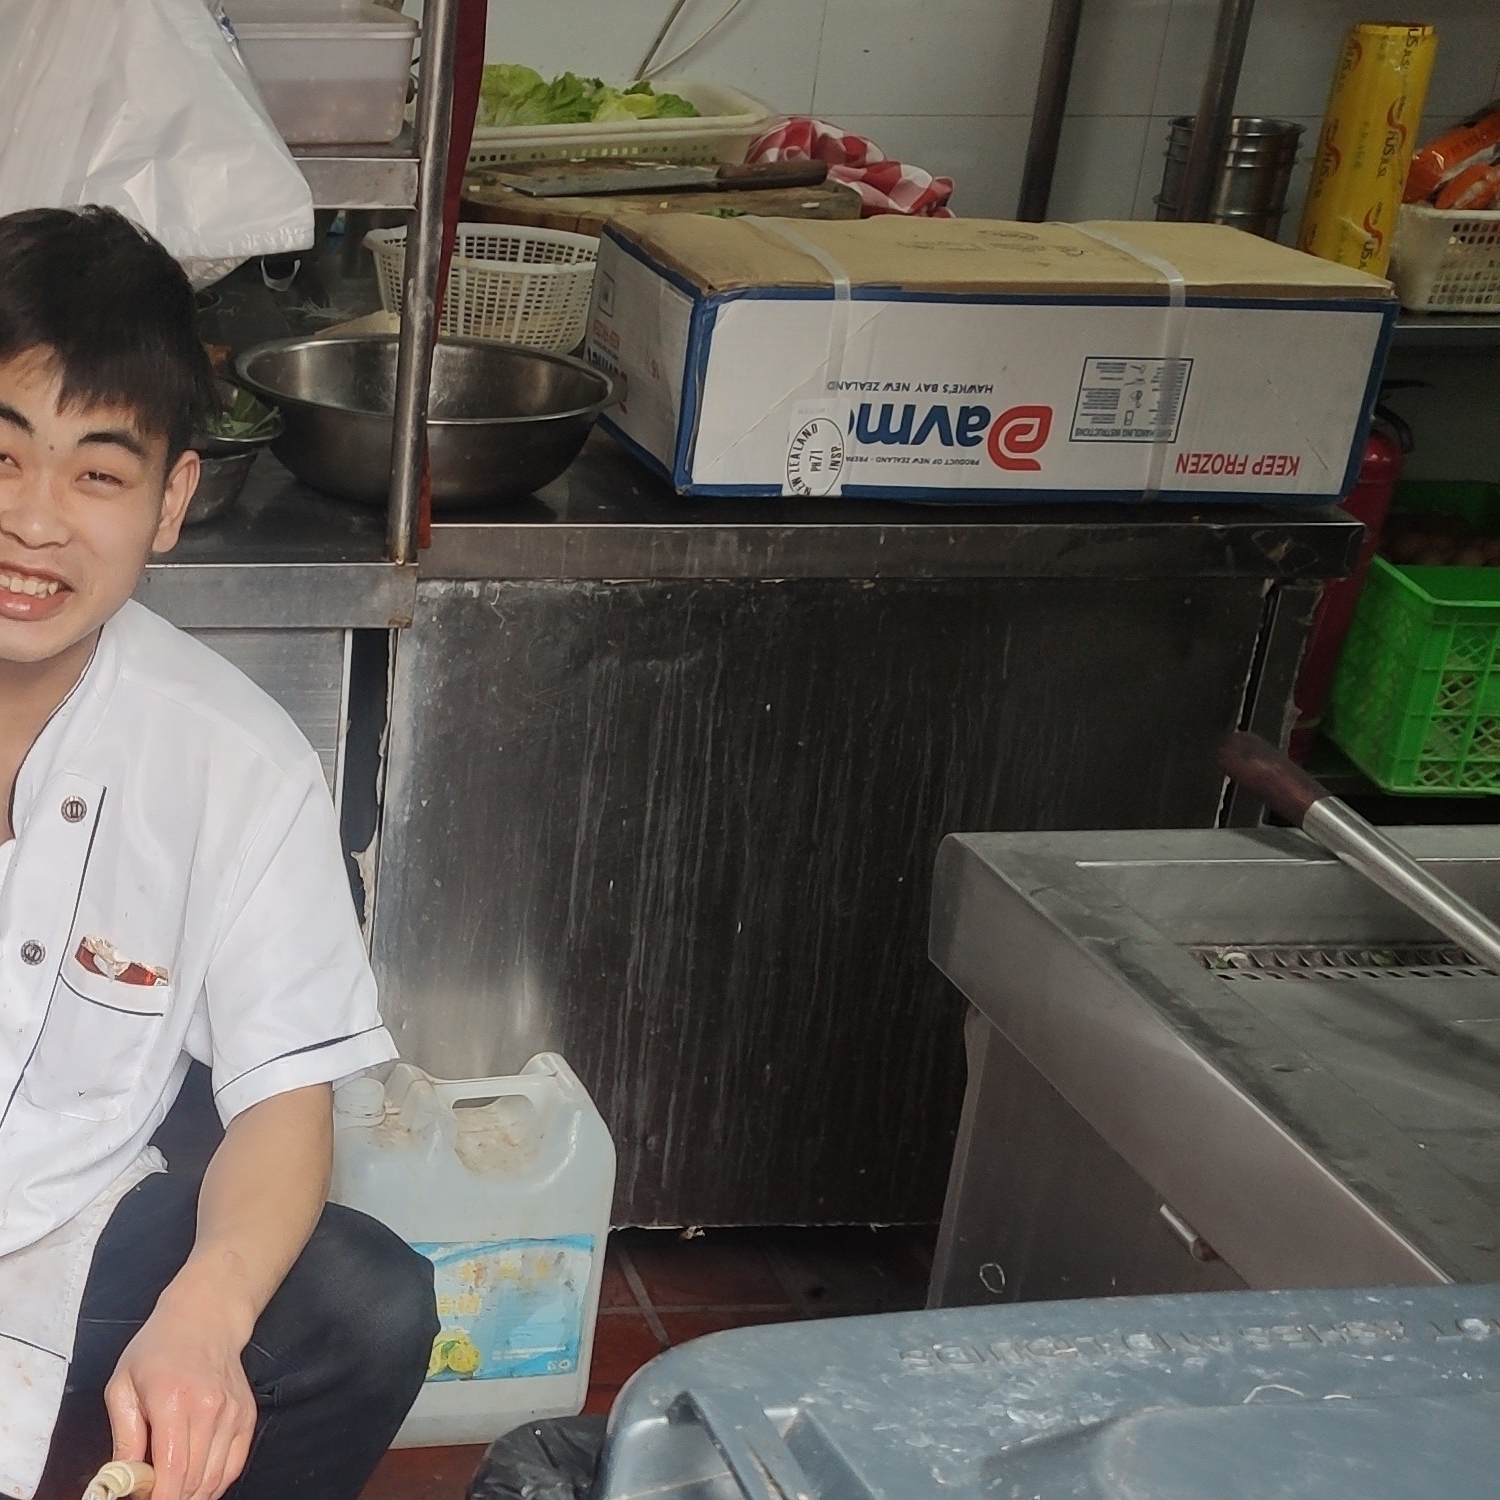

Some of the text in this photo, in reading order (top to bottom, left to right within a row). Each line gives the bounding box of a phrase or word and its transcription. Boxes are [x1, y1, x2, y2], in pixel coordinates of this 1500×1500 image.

[826, 381, 994, 394] HAWKE'S BAY NEW ZEALAND
[1175, 452, 1300, 476] KEEP FROZEN
